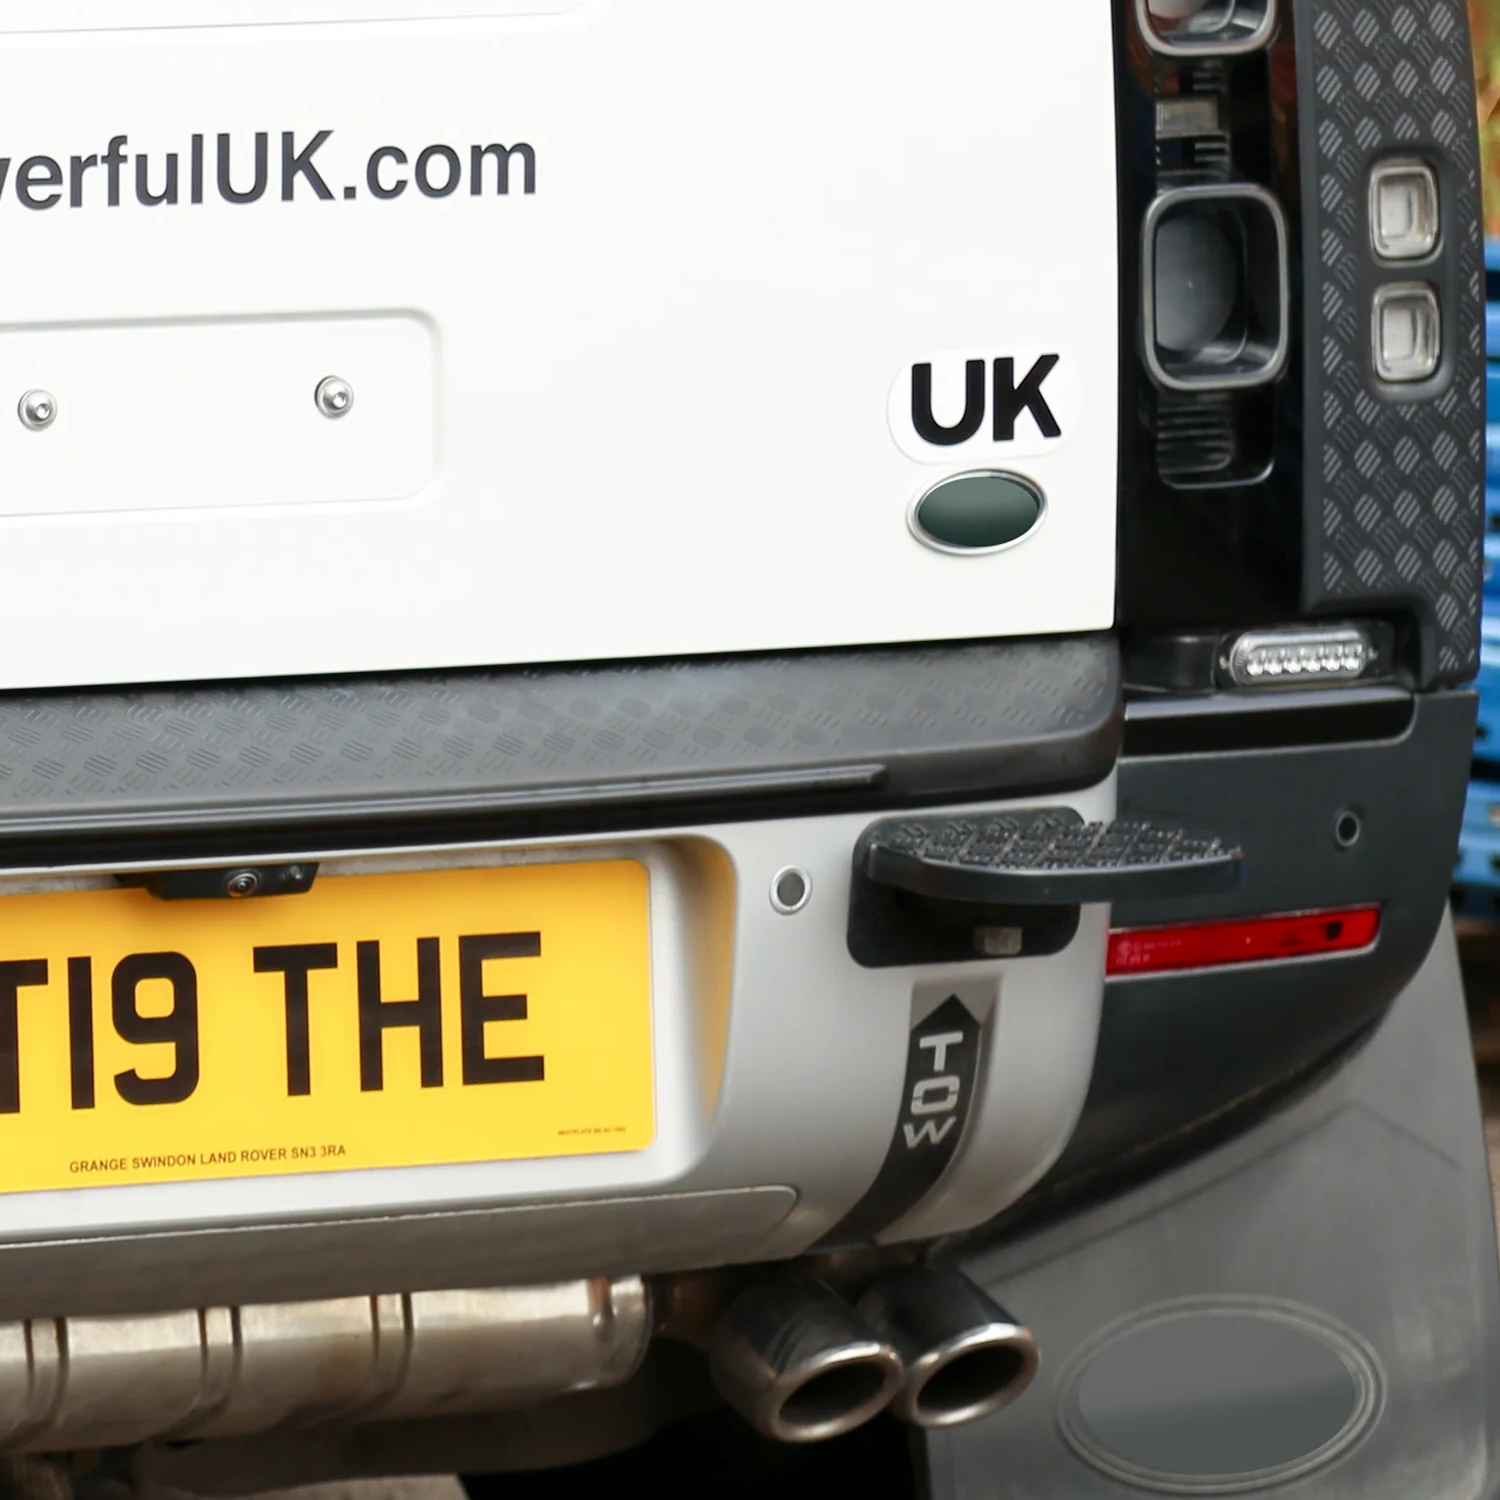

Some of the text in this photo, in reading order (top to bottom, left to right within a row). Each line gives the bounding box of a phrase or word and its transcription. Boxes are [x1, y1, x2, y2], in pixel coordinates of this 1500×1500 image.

[911, 354, 1062, 446] UK
[253, 931, 545, 1097] THE
[902, 1030, 964, 1150] TOW
[69, 1144, 347, 1173] GRANGE SWINDON LAND ROVER SN3 3RA
